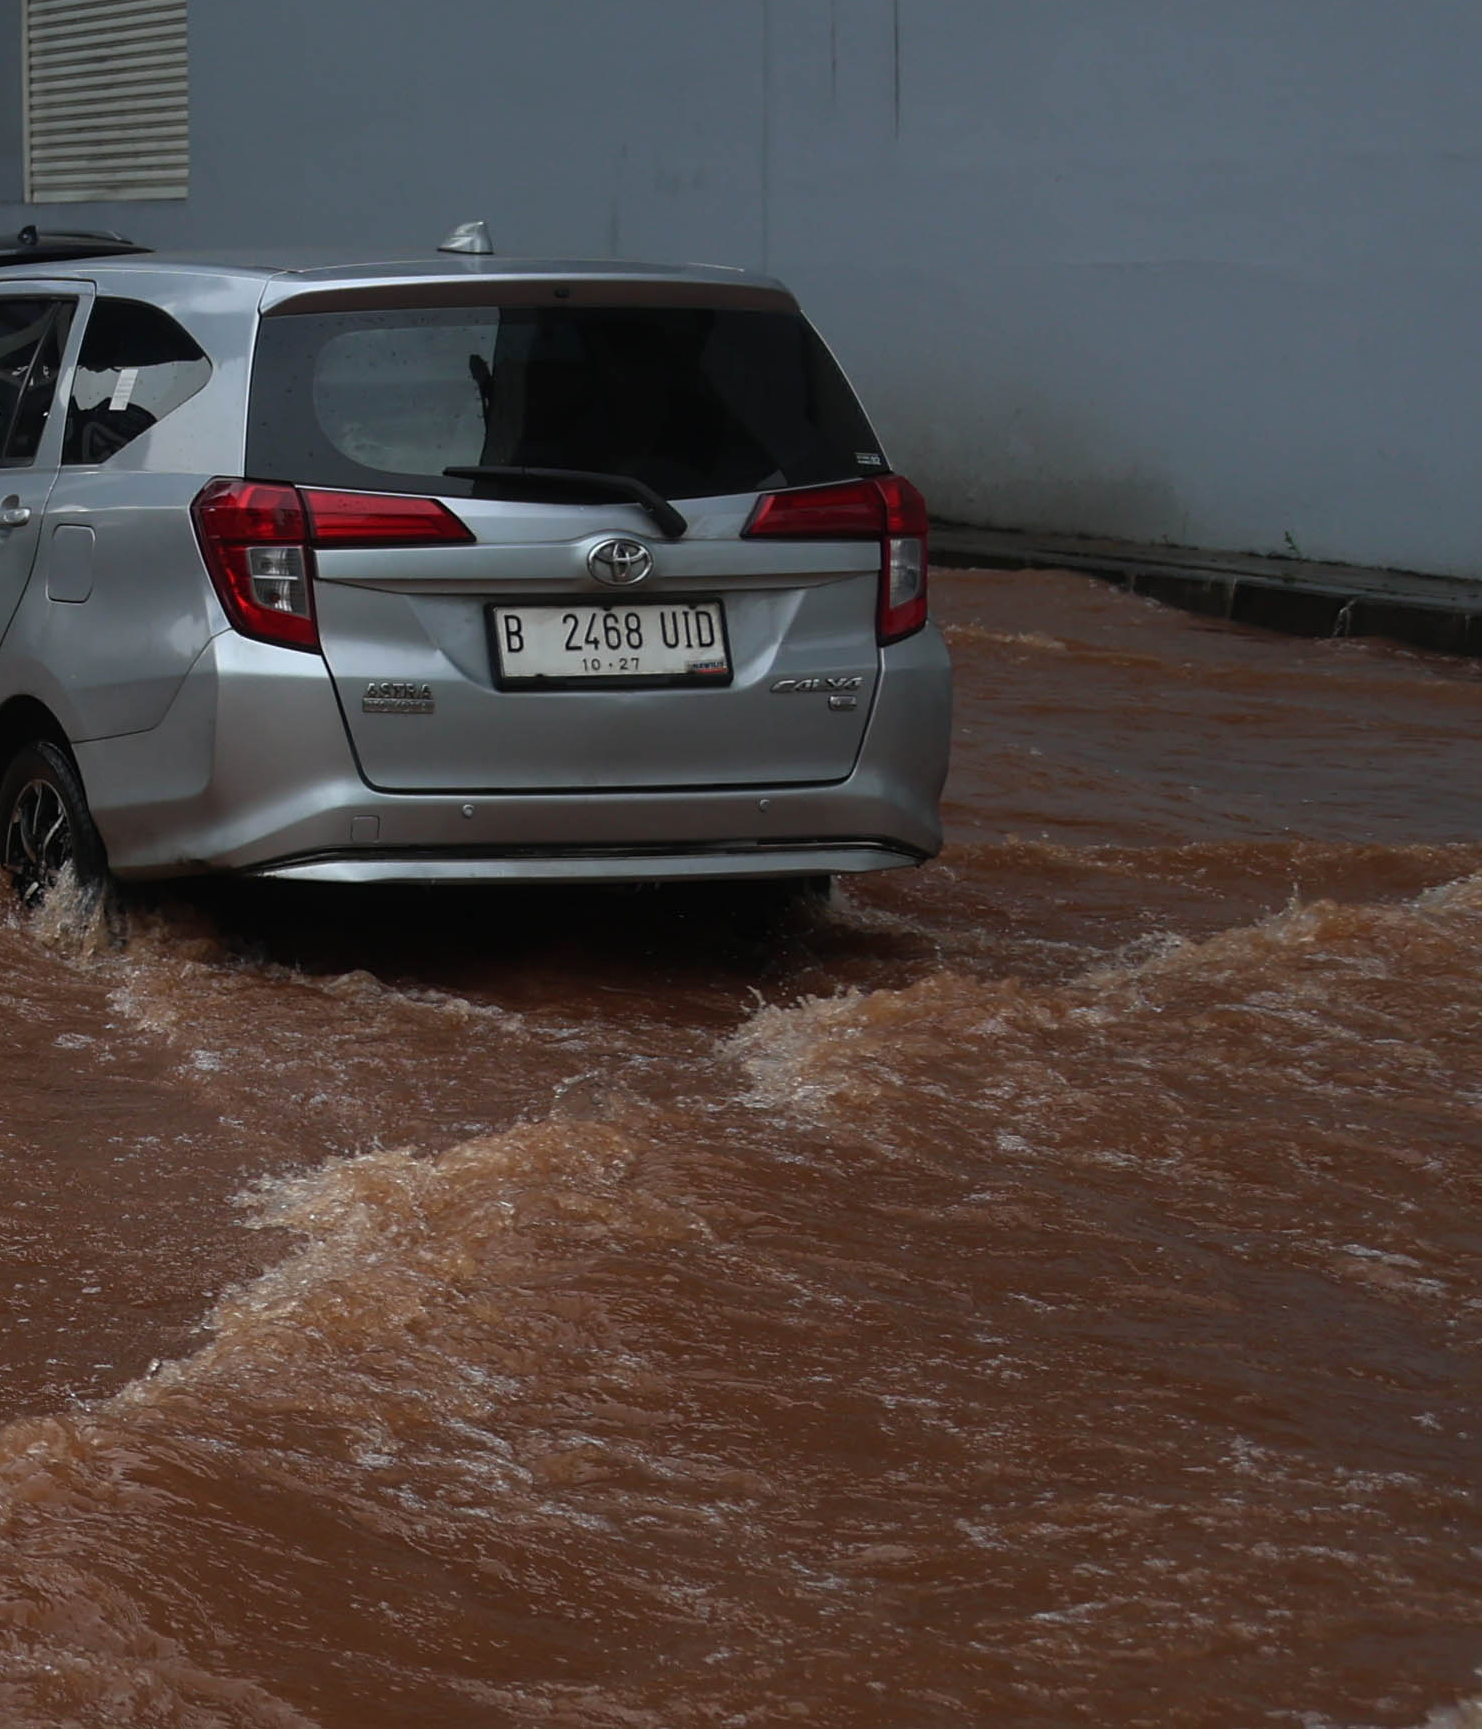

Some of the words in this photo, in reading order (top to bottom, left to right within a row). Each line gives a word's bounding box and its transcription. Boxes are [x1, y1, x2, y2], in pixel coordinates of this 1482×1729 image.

[503, 615, 525, 653] B
[562, 613, 643, 652] 2468
[660, 611, 715, 649] UID
[367, 682, 431, 698] ASTRA
[771, 676, 863, 692] CALYA
